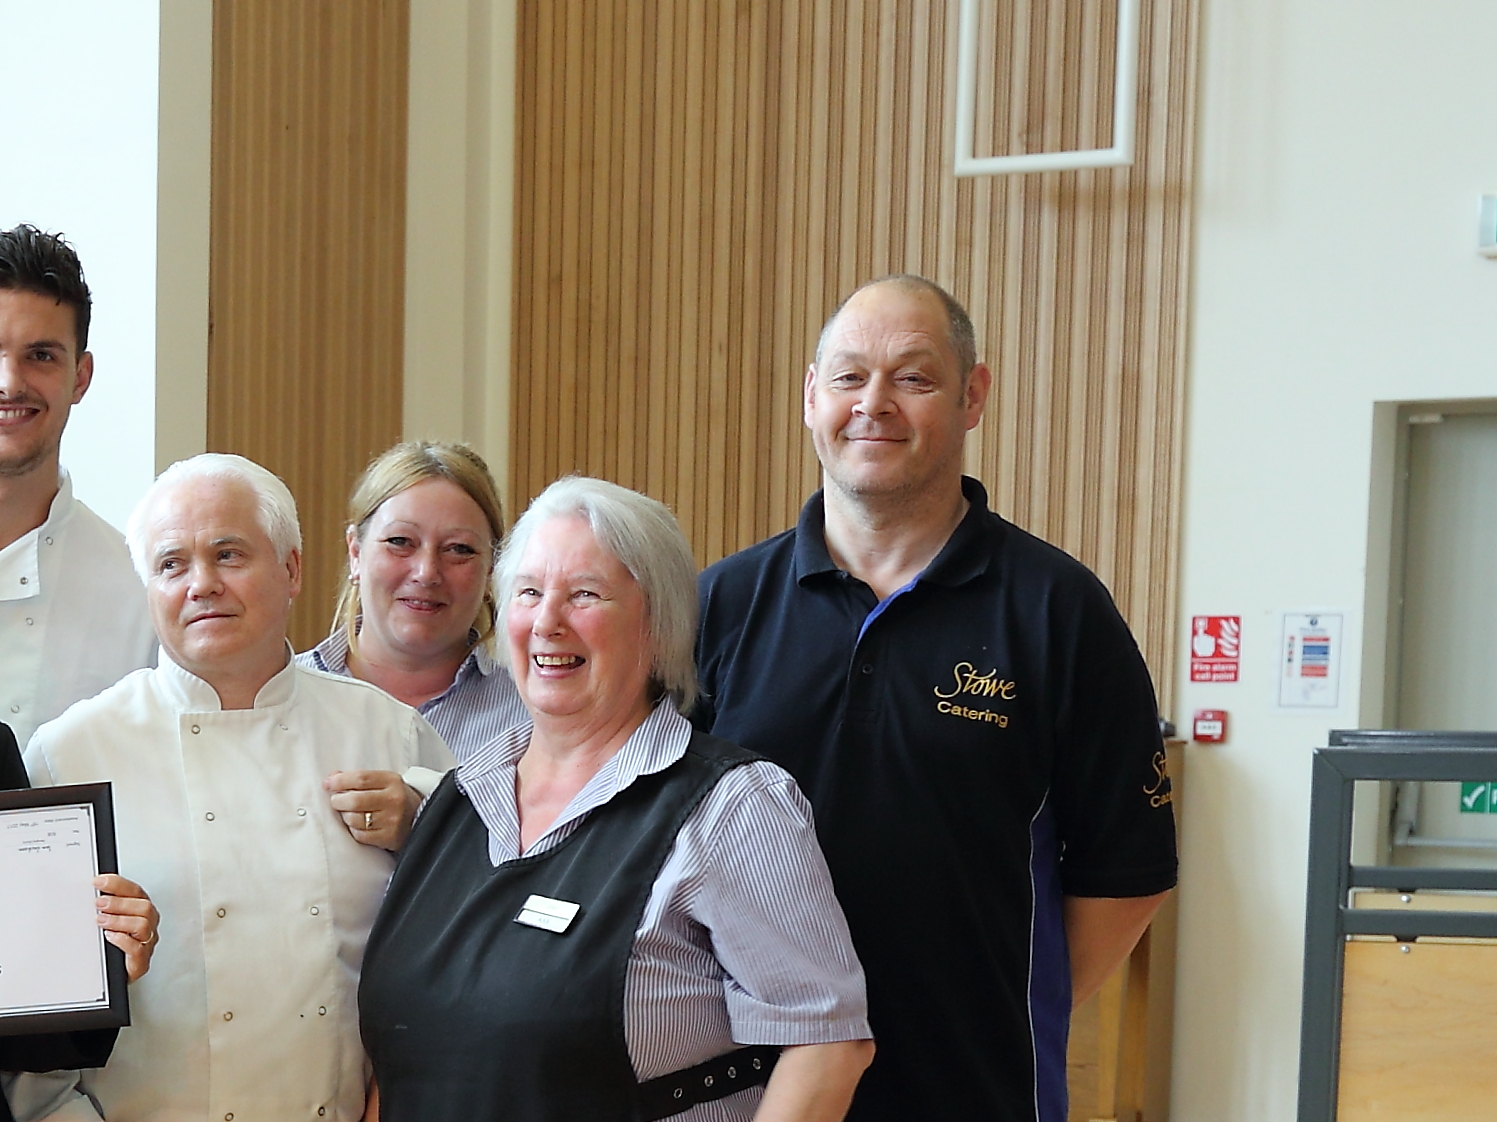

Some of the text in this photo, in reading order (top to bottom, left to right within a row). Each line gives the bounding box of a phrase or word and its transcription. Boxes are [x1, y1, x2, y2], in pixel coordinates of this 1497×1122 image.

[1194, 663, 1237, 671] Fire alarm
[1195, 671, 1235, 681] call point
[933, 661, 1017, 700] Stowe
[936, 700, 1009, 728] Catering
